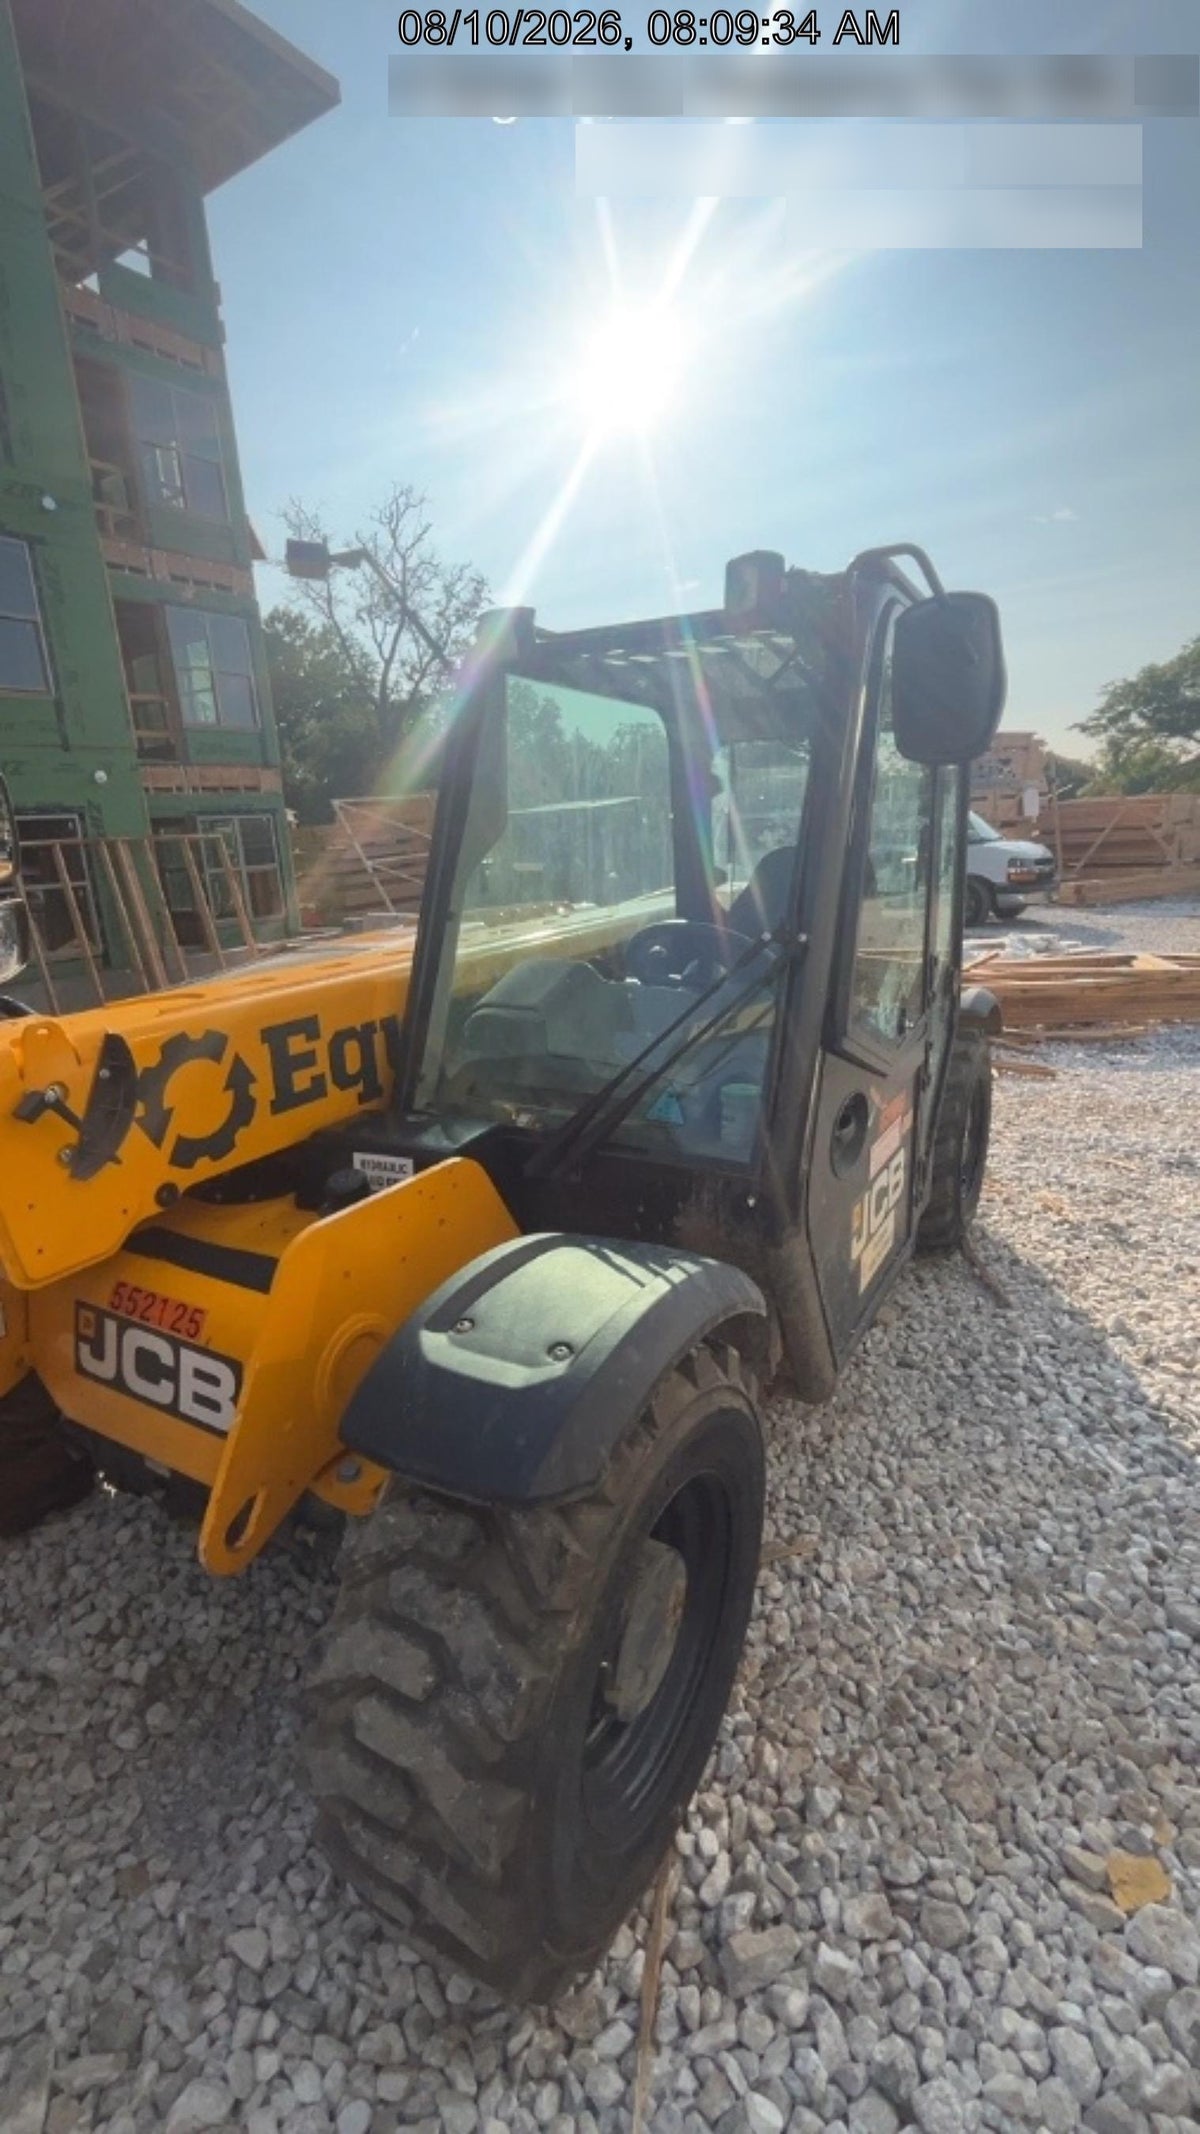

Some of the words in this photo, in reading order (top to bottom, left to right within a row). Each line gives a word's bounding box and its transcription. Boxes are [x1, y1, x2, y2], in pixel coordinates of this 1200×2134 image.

[852, 1148, 905, 1260] JCB
[110, 1281, 204, 1339] 552125
[78, 1318, 236, 1431] JCB
